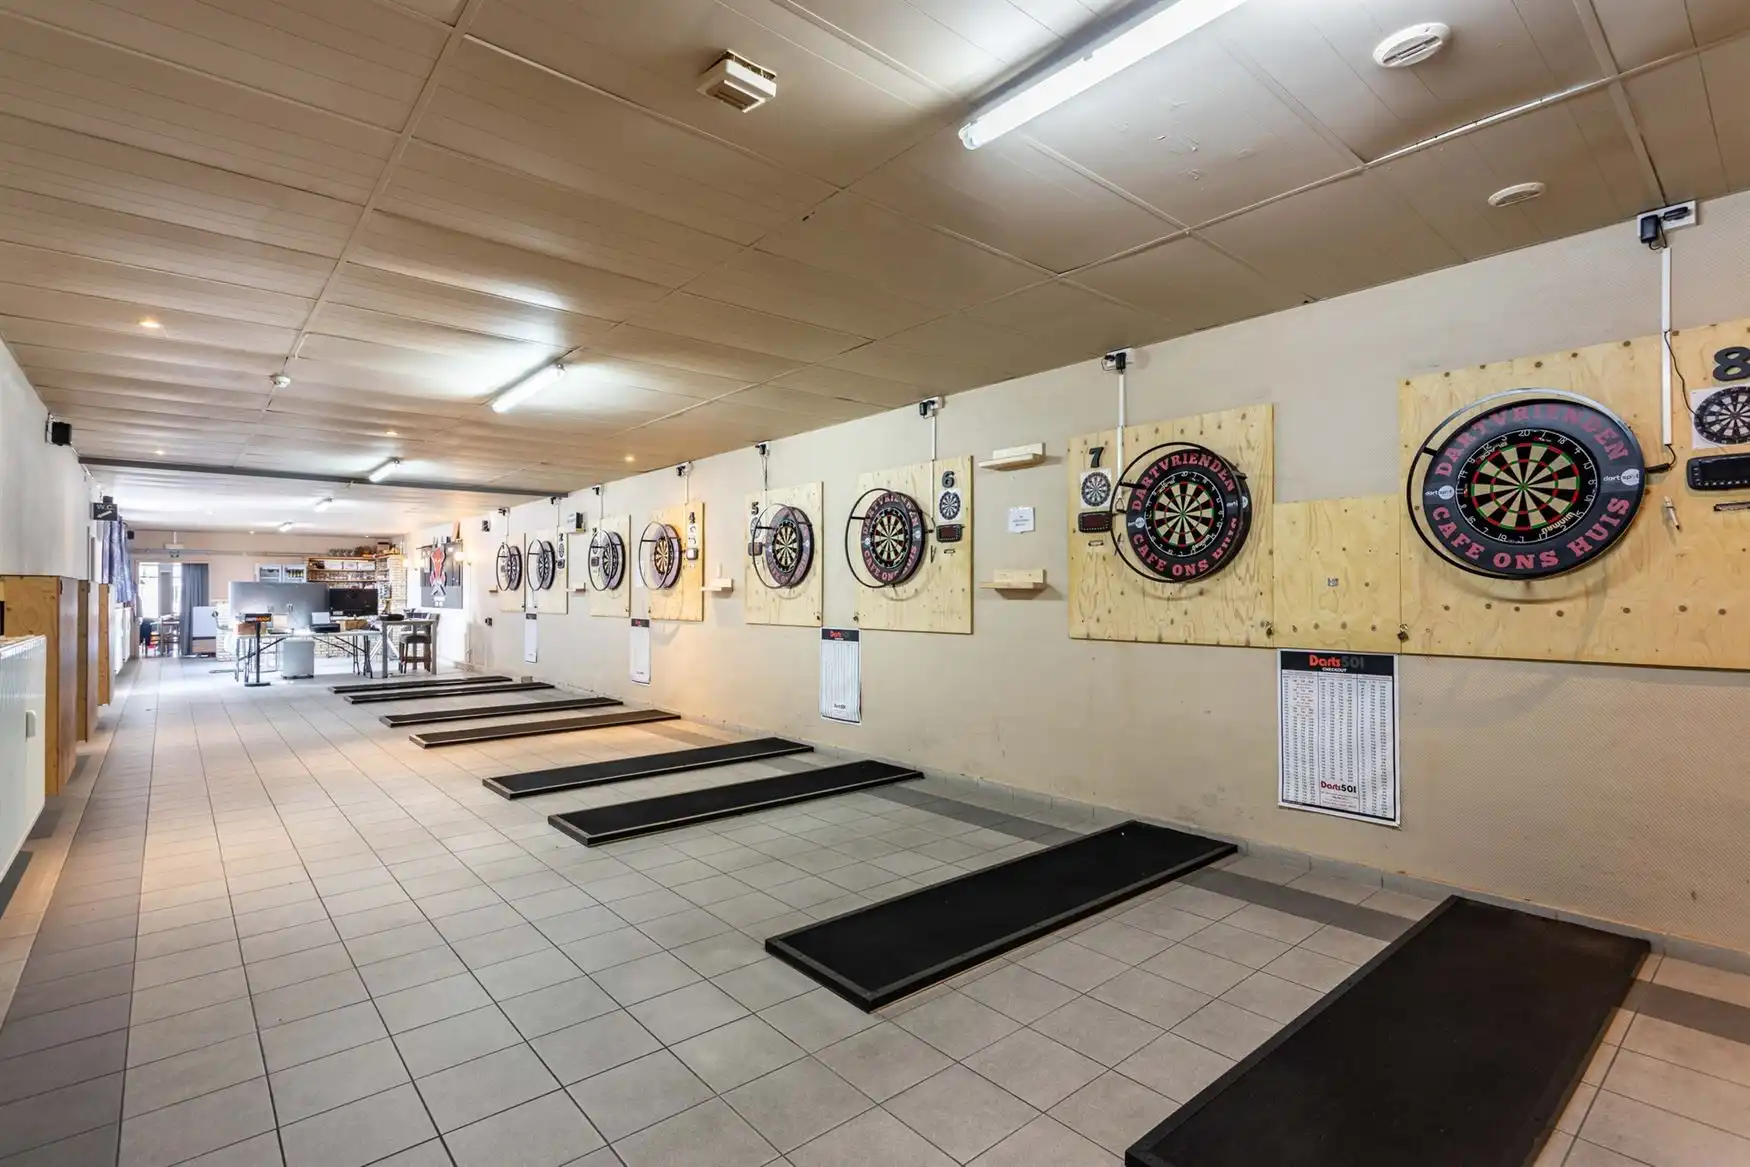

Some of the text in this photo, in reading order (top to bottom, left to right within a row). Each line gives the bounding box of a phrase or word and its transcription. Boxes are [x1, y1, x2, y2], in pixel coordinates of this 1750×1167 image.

[1713, 346, 1750, 382] 8
[1089, 447, 1105, 468] 7
[942, 470, 955, 488] 6
[751, 502, 759, 515] 5
[1432, 497, 1630, 569] CAFE ONS HUIS
[1133, 533, 1167, 572] CAFE
[1172, 559, 1209, 577] ONS
